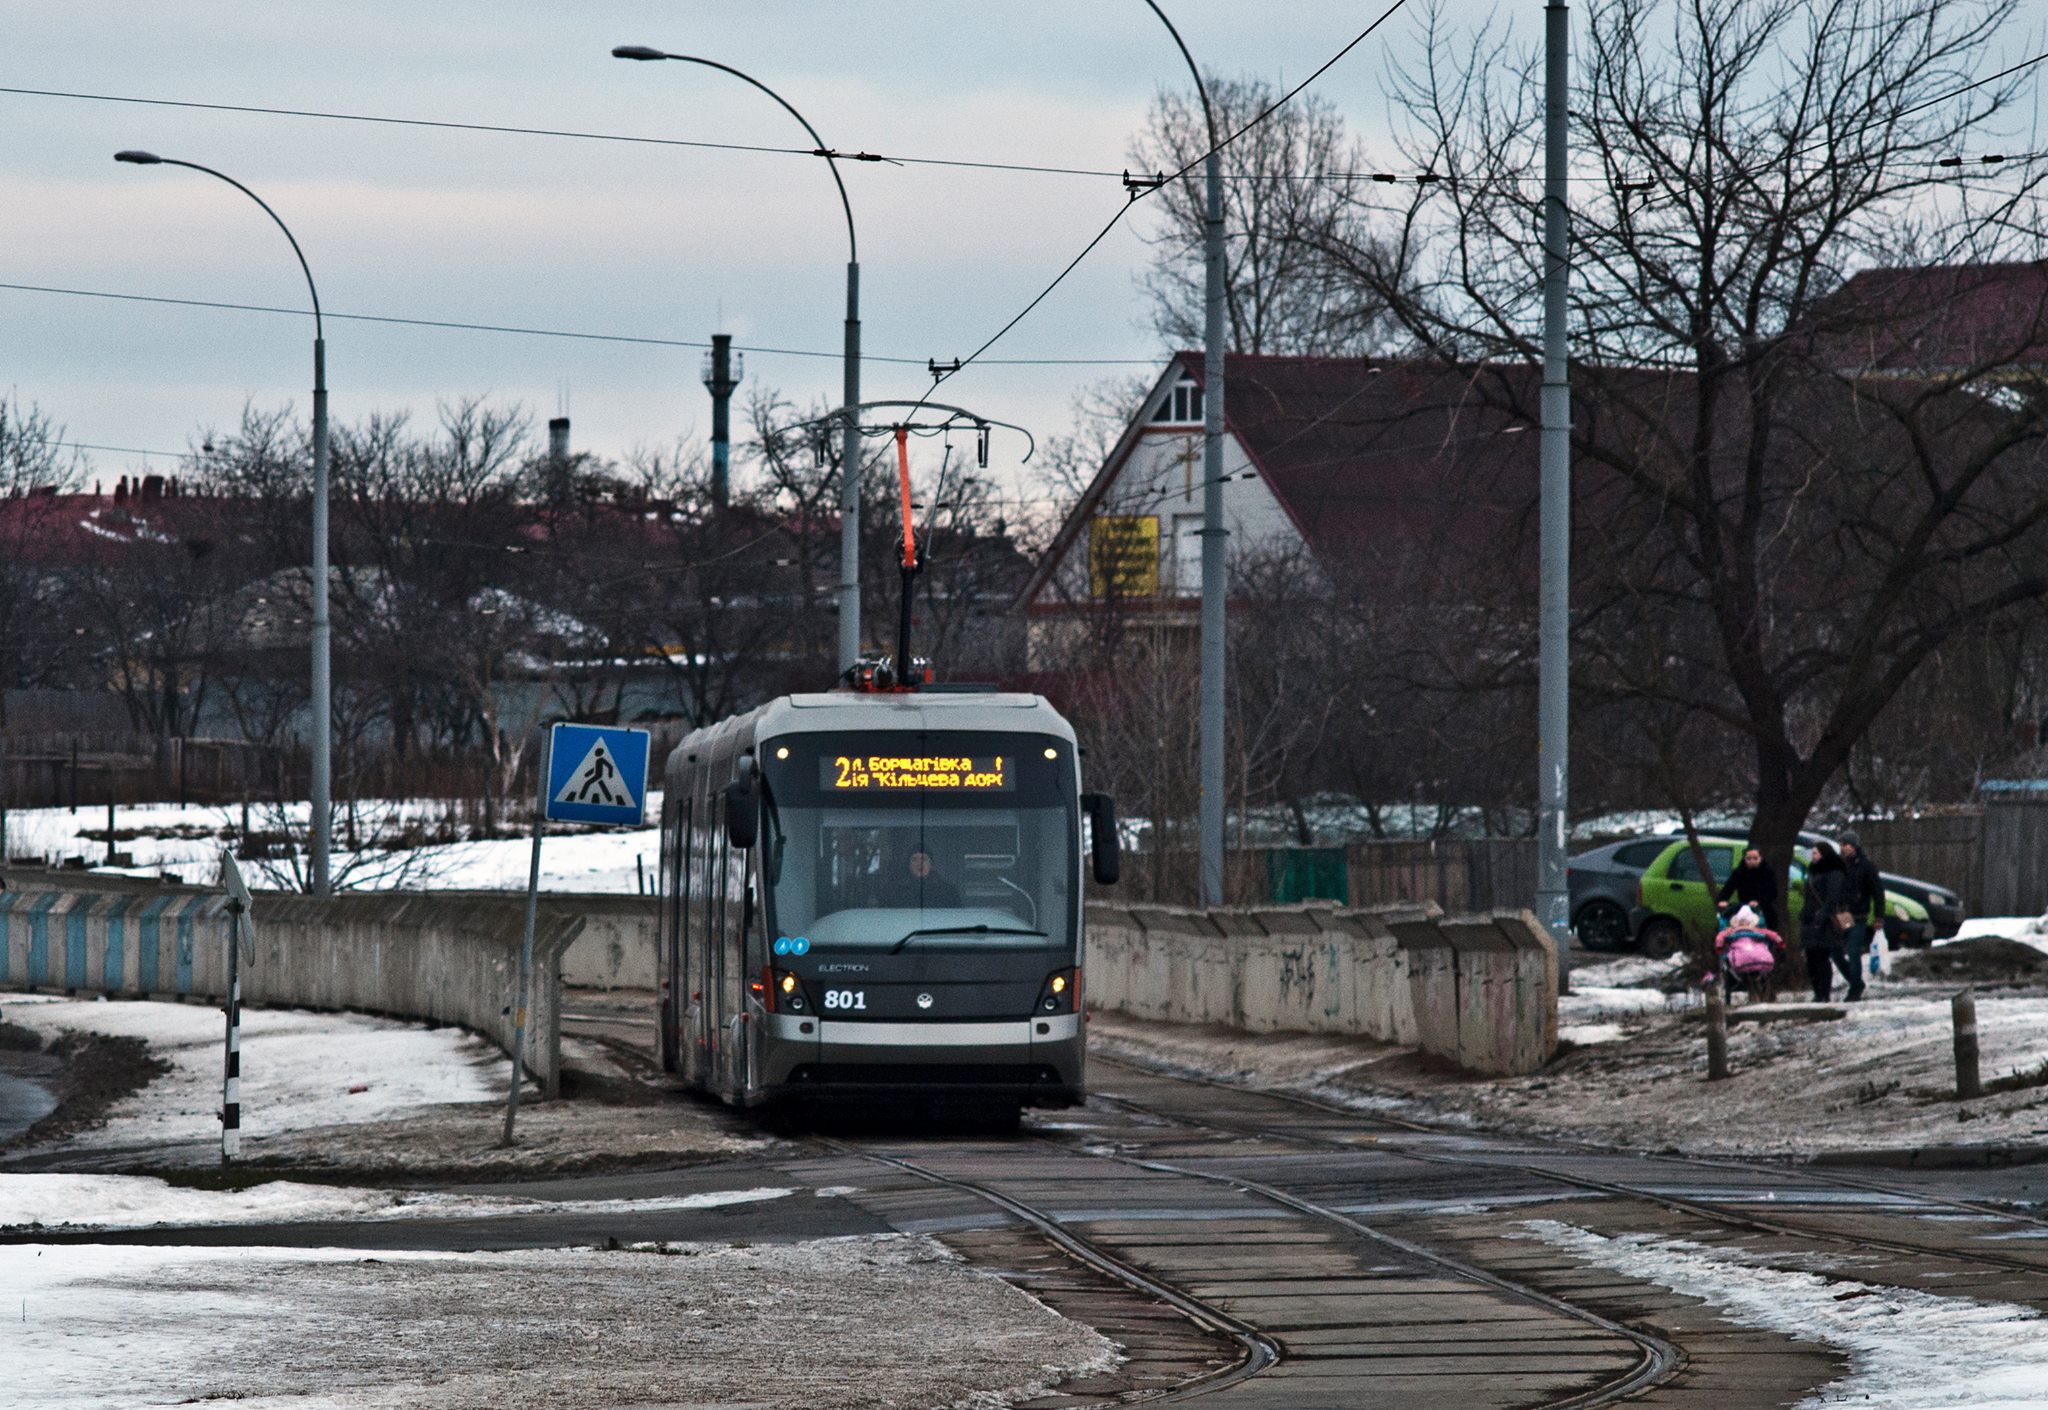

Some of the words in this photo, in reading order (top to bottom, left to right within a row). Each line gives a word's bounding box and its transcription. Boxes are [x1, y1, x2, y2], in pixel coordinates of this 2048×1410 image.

[835, 756, 851, 787] 2
[818, 964, 869, 972] ELECTRON
[824, 990, 867, 1009] 801
